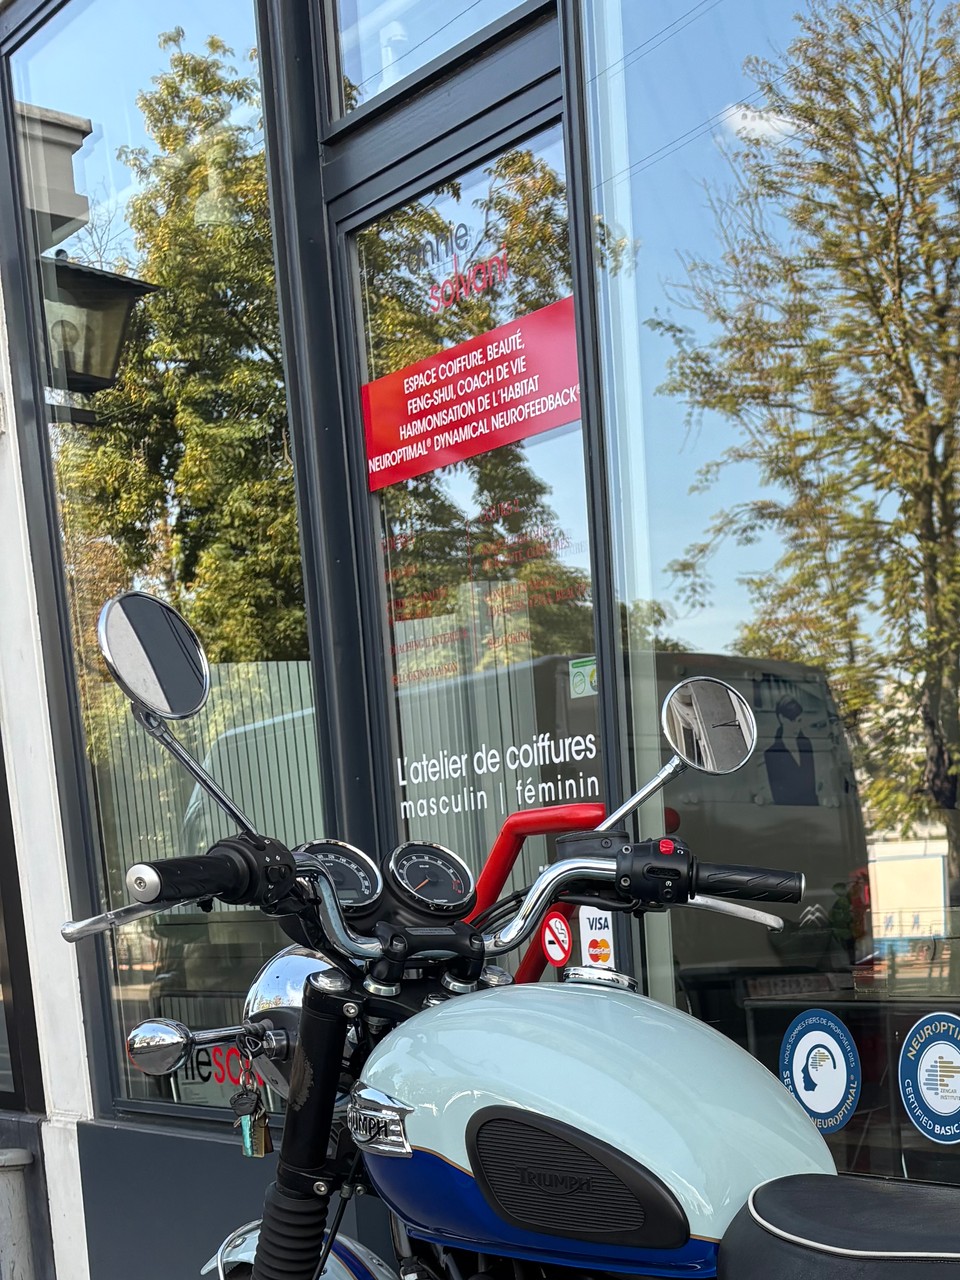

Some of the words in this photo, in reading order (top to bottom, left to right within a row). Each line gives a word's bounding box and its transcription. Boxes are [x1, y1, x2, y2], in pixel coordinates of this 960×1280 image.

[429, 242, 510, 313] solvani
[403, 369, 437, 395] ESPACE
[438, 351, 487, 381] COIFFURE,
[486, 327, 526, 361] BEAUTÉ,
[407, 384, 458, 416] FENG-SHUI,
[457, 373, 495, 398] COACH
[495, 364, 509, 381] DE
[510, 356, 527, 377] VIE
[399, 406, 476, 441] HARMONISATION
[477, 397, 491, 413] DE
[492, 374, 540, 408] L'HABITAT
[433, 422, 490, 451] DYNAMICAL
[397, 750, 468, 787] L'atelier
[473, 744, 500, 775] de
[506, 732, 597, 771] coiffures
[400, 787, 488, 819] masculin
[516, 772, 600, 805] féminin
[586, 917, 610, 931] VISA
[805, 1016, 820, 1026] FIERS
[904, 1079, 934, 1130] CERTIFIED
[934, 1123, 960, 1136] BASIC
[515, 1165, 593, 1196] TRIUMPH
